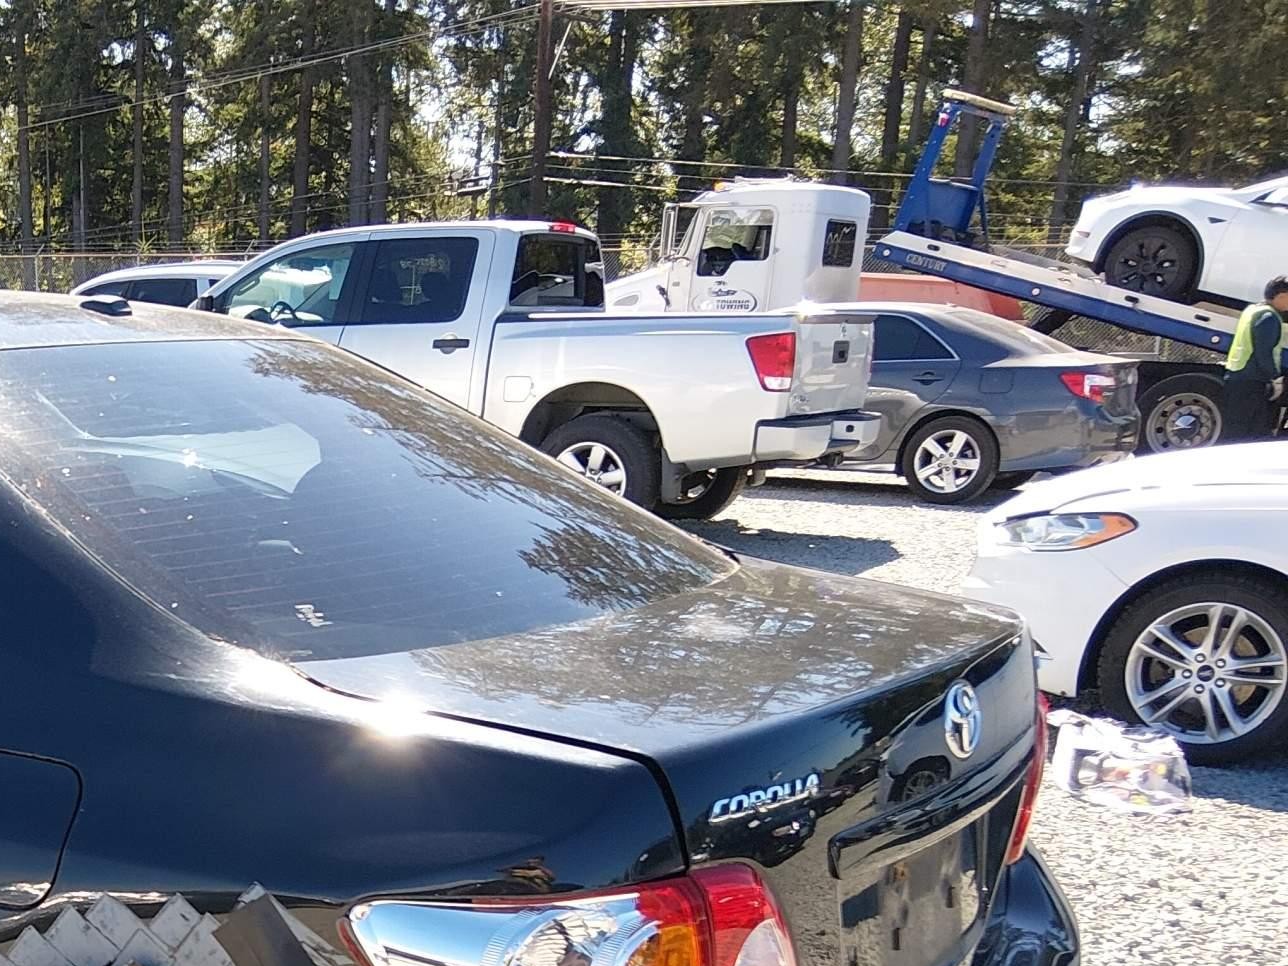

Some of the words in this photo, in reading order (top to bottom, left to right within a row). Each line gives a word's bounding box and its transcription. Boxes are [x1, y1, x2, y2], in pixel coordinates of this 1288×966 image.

[905, 253, 948, 272] CENTURY
[716, 299, 751, 310] TOWING
[709, 772, 820, 822] COROLLA
